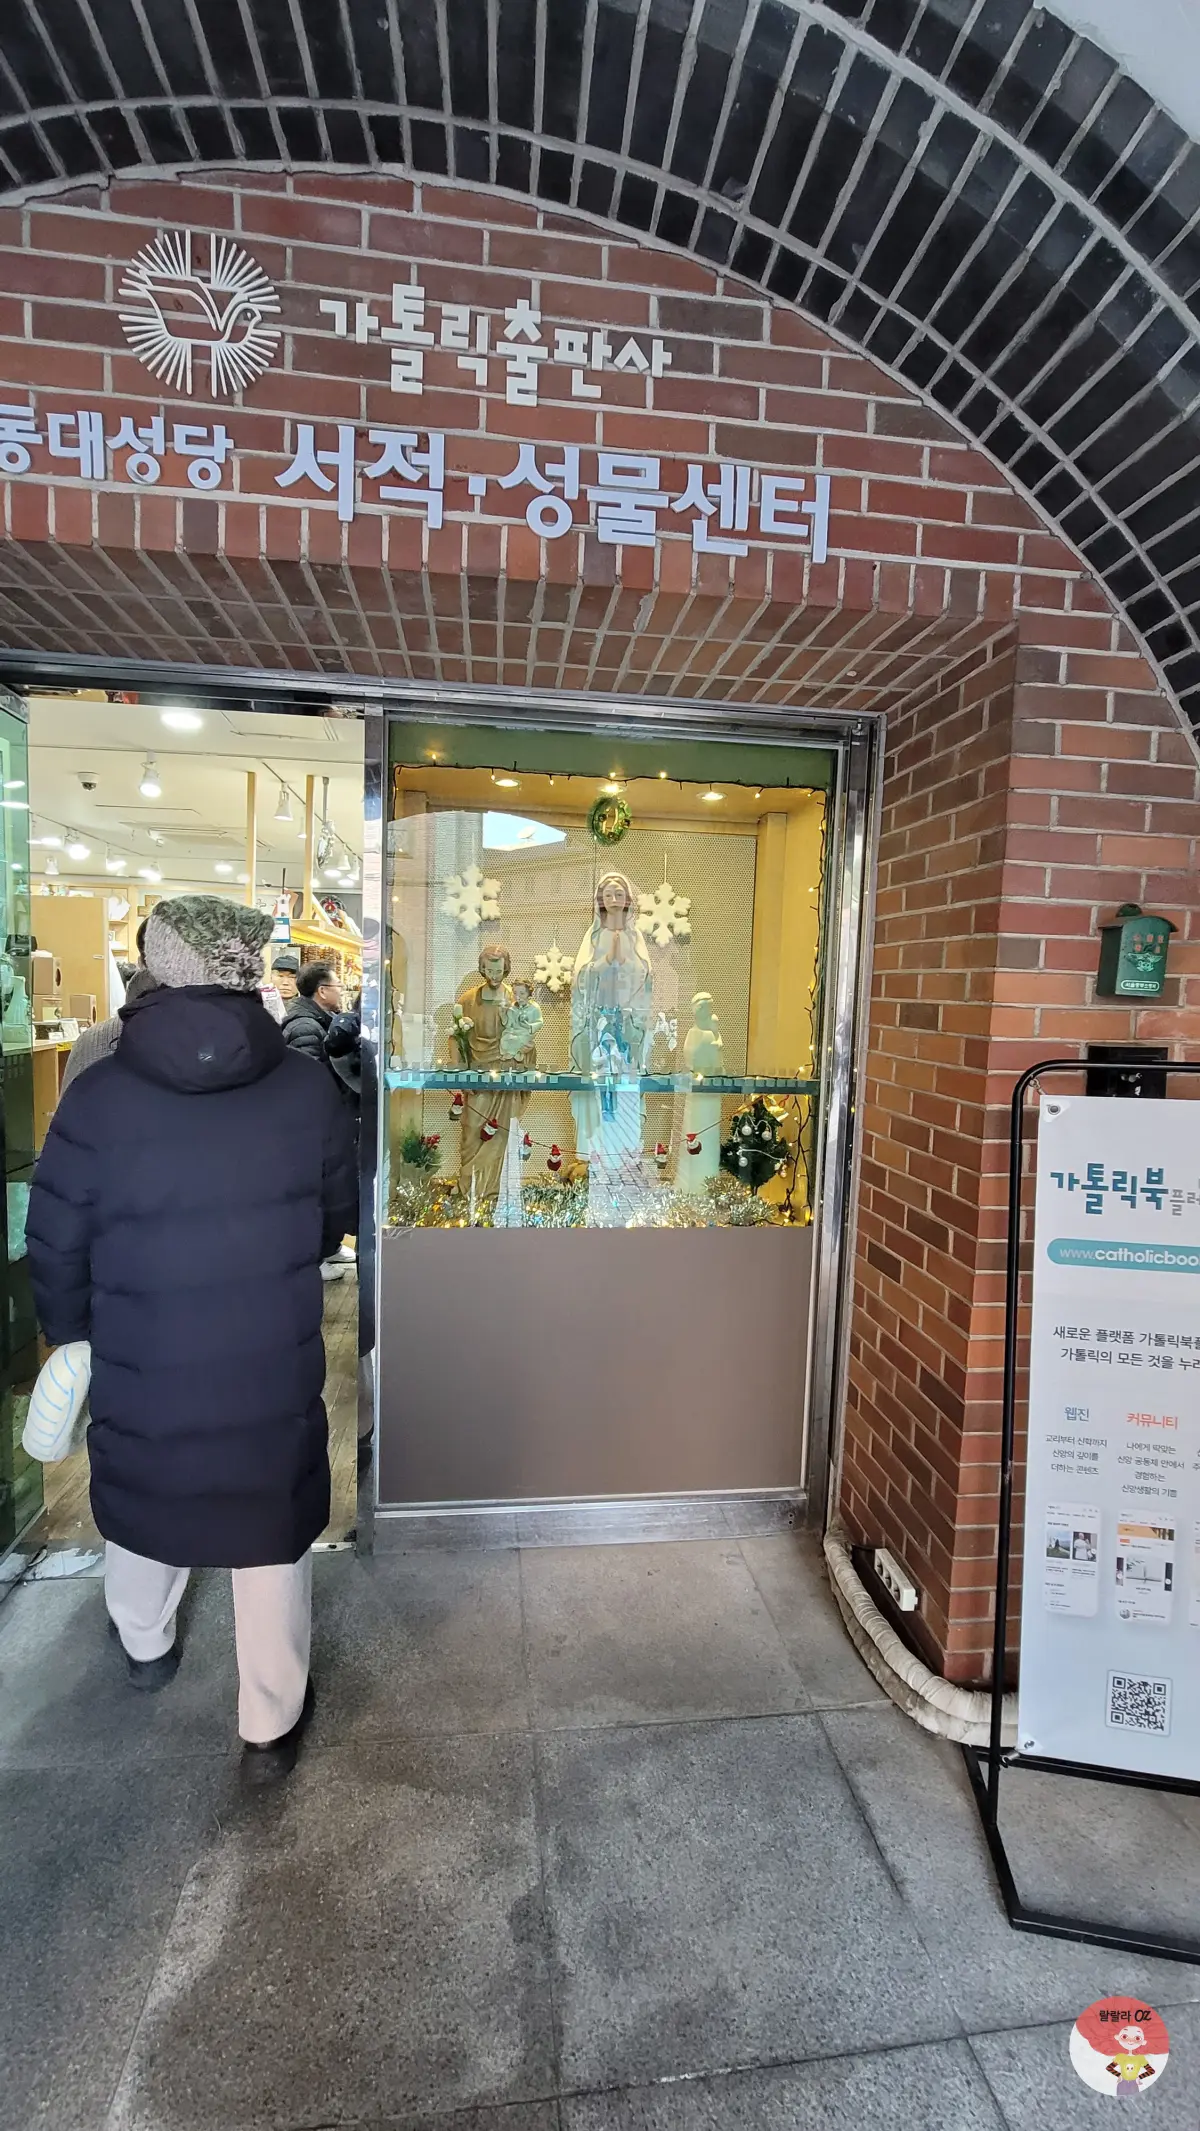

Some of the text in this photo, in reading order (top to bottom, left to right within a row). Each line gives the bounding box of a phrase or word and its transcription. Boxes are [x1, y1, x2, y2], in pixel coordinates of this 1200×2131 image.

[320, 283, 673, 407] 가톨릭출판사
[0, 404, 234, 491] 동대성당
[1060, 1248, 1200, 1267] www.catholicboo
[1053, 1325, 1091, 1342] 새로운
[1095, 1328, 1135, 1344] 플랫폼
[1061, 1347, 1112, 1364] 가톨릭의
[1116, 1352, 1144, 1367] 모든
[1147, 1355, 1175, 1370] 것을
[1064, 1406, 1178, 1430] 웹진 커뮤니티
[1045, 1434, 1108, 1448] 교리부터 신학까지
[1126, 1442, 1177, 1454] 나에게 딱맞는
[1052, 1448, 1099, 1461] 신앙의 깊이를
[1051, 1463, 1074, 1474] 더하는
[1117, 1455, 1185, 1469] 신앙 공동체 안에서
[1134, 1471, 1166, 1482] 경험하는
[1121, 1484, 1178, 1498] 신앙생활의 기쁨
